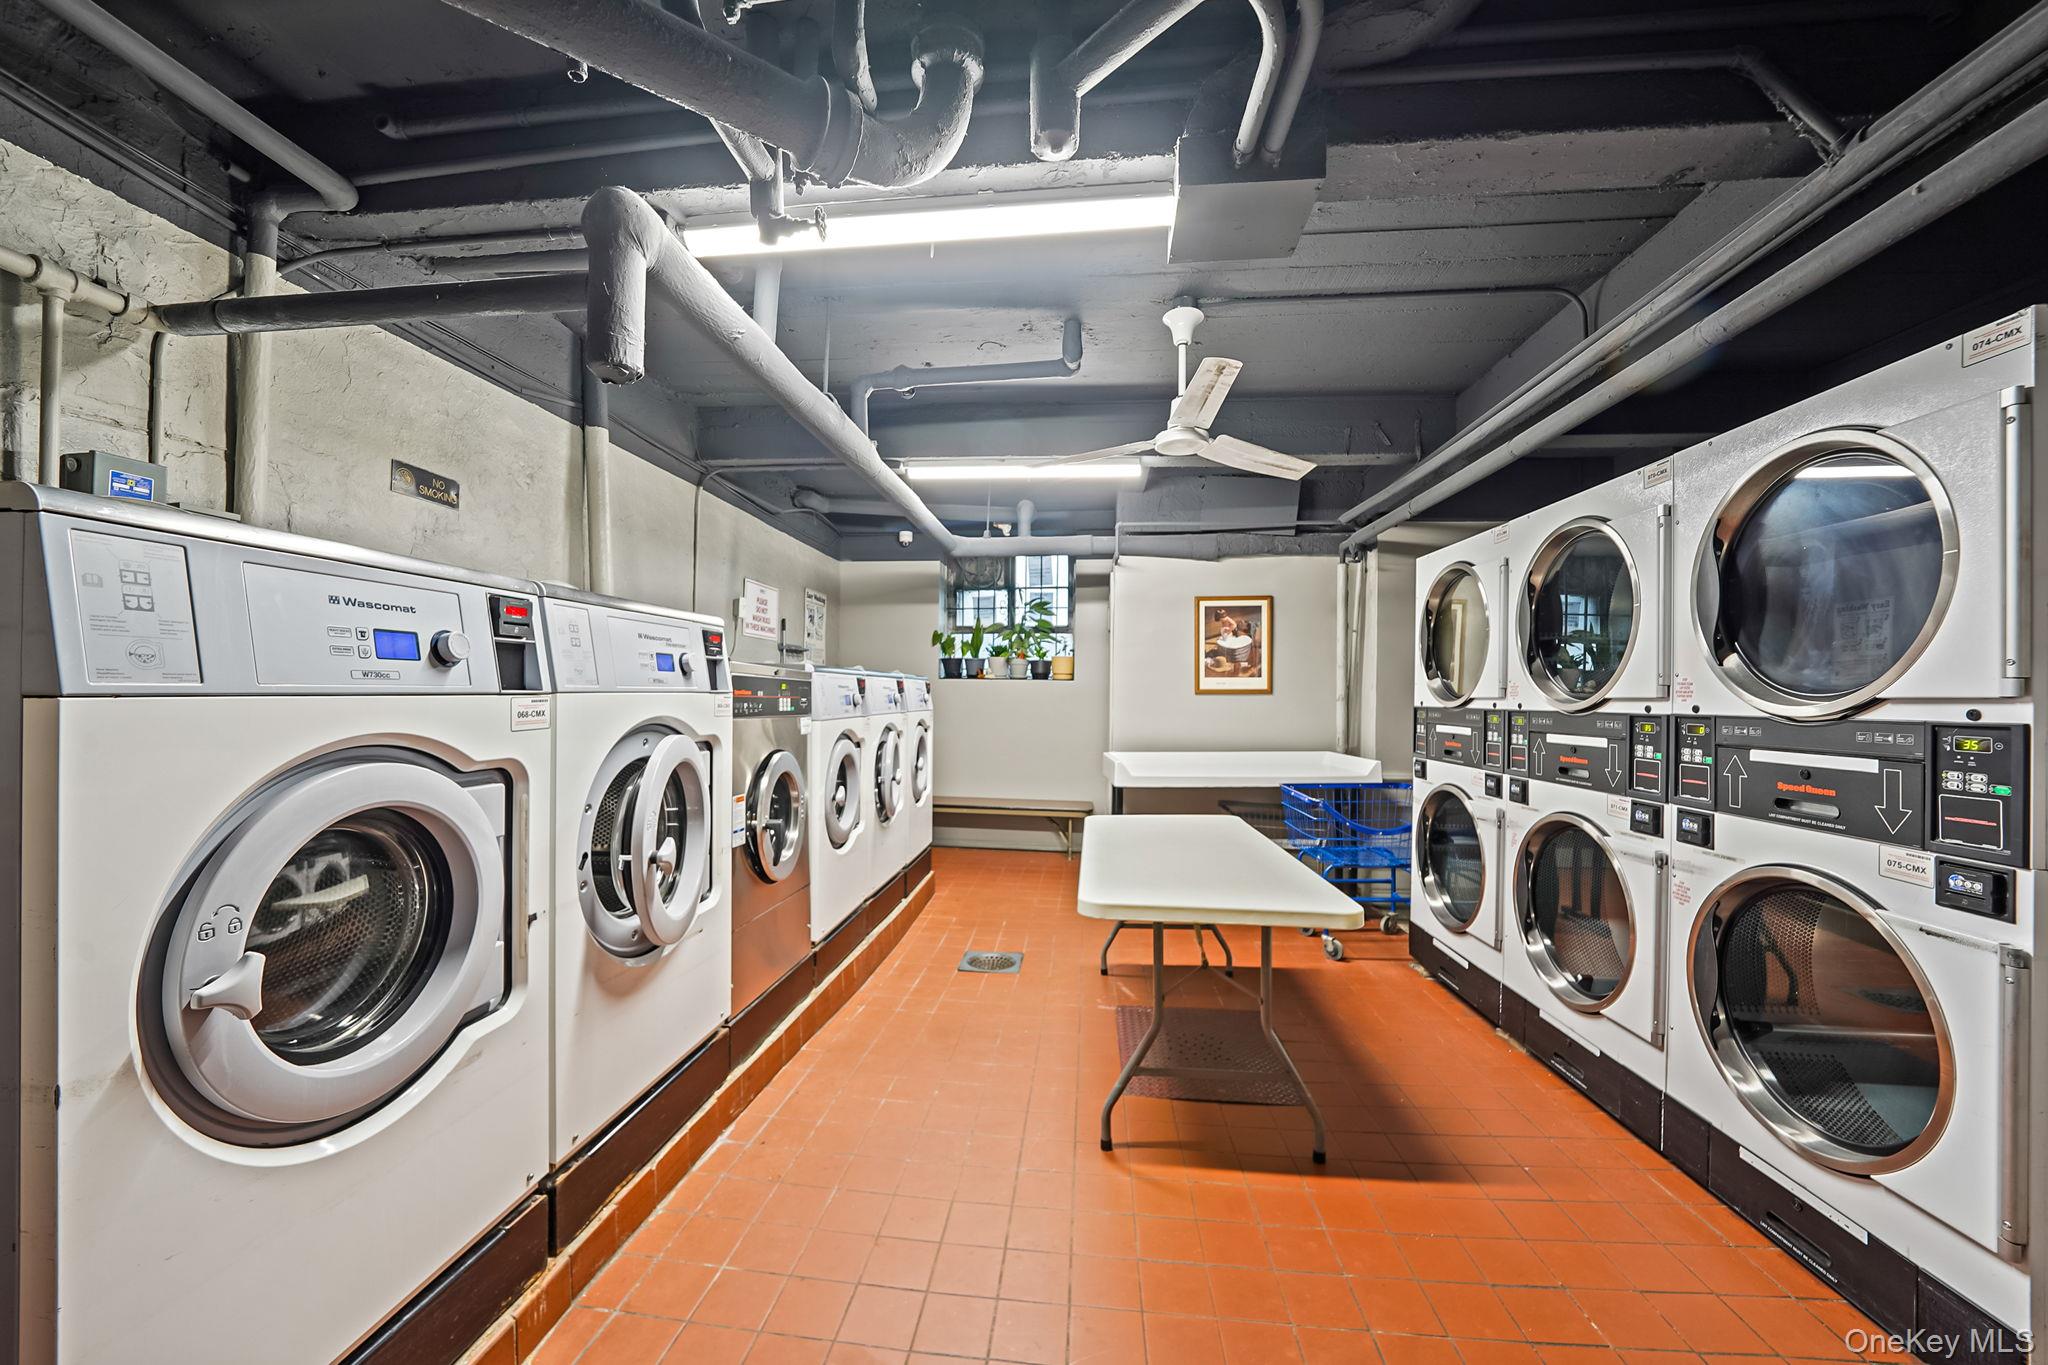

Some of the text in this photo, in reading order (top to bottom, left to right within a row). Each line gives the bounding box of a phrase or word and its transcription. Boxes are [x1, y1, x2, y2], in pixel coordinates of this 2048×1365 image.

[1972, 325, 2022, 351] 074-CMX
[432, 478, 446, 490] NO
[419, 485, 457, 504] SMOKING
[342, 596, 417, 614] Wascomat
[361, 671, 391, 679] W730cc
[517, 710, 546, 719] 068-CMX
[1962, 740, 1979, 750] 35
[1776, 781, 1836, 797] Speed Queen
[1886, 859, 1927, 875] 075-CMX
